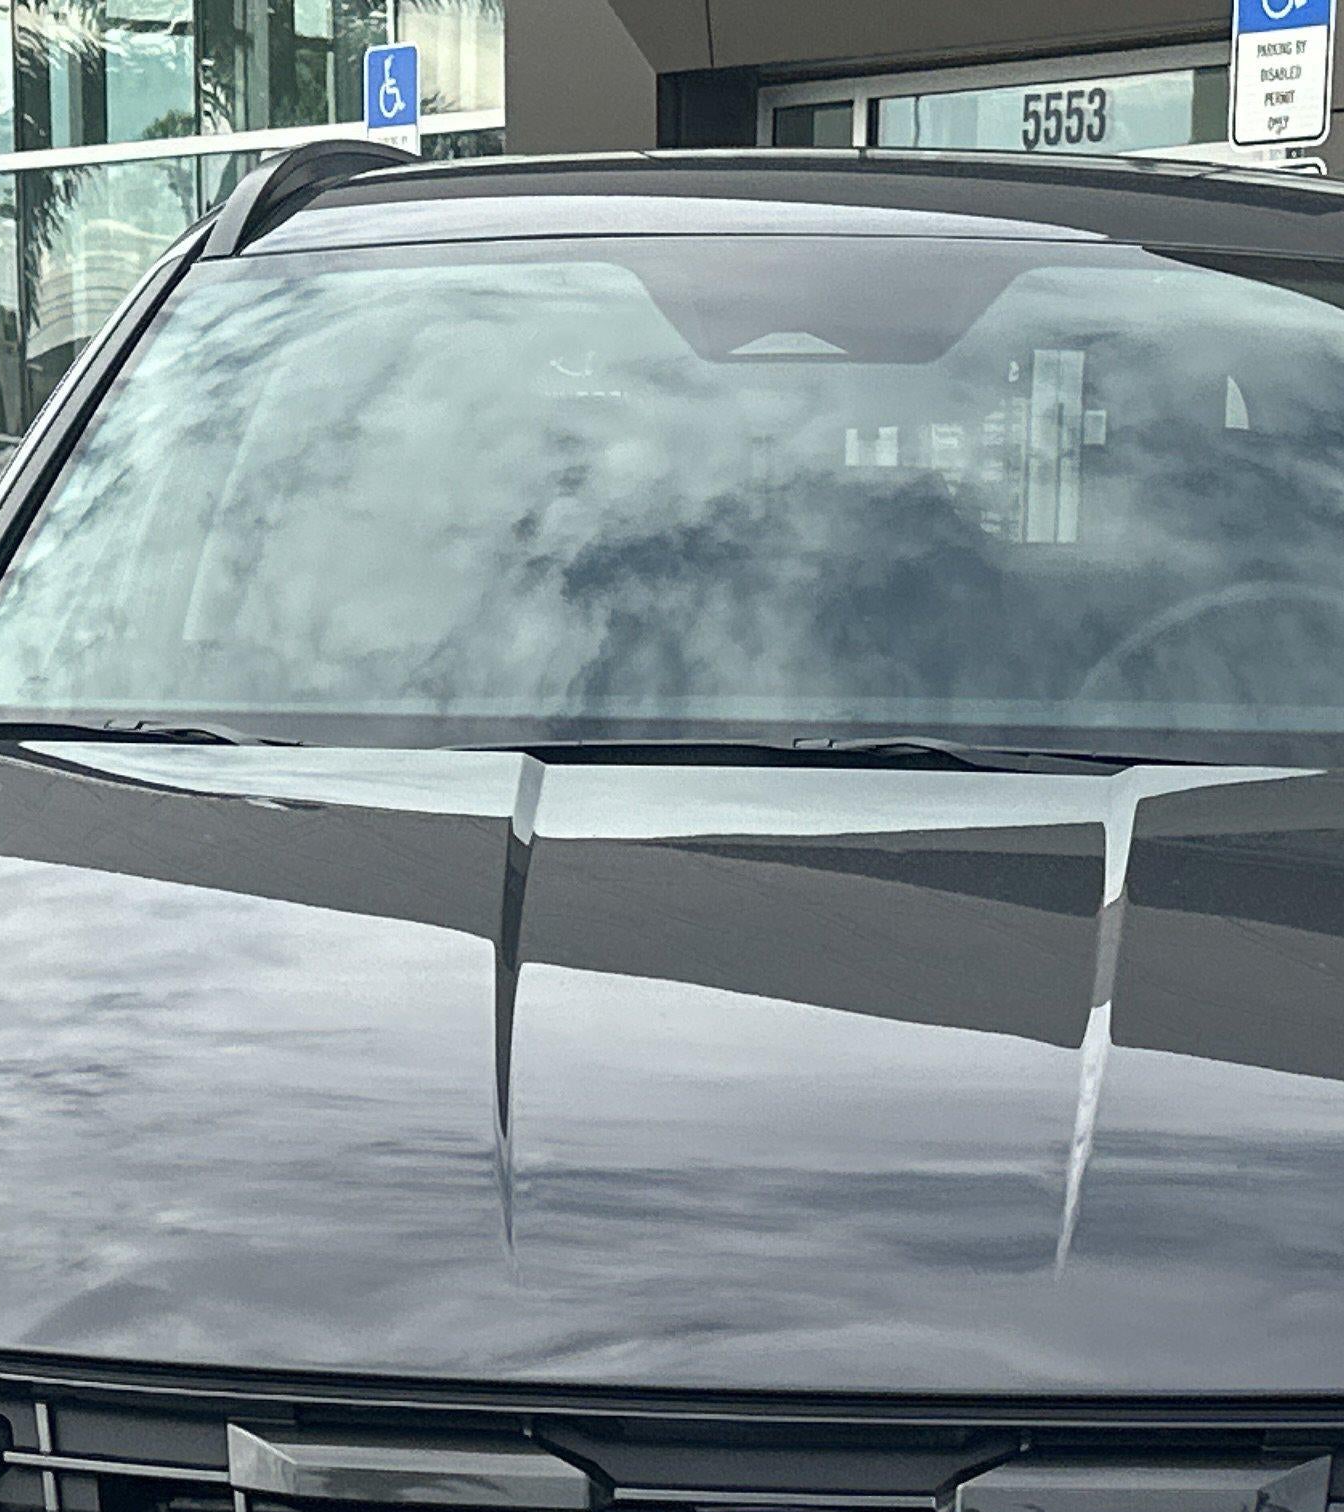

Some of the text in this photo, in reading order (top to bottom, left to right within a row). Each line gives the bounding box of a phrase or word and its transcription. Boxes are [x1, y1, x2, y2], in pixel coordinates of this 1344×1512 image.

[1256, 39, 1308, 58] PARKING BY
[1260, 65, 1302, 82] DISABLED
[1022, 87, 1106, 149] 5553
